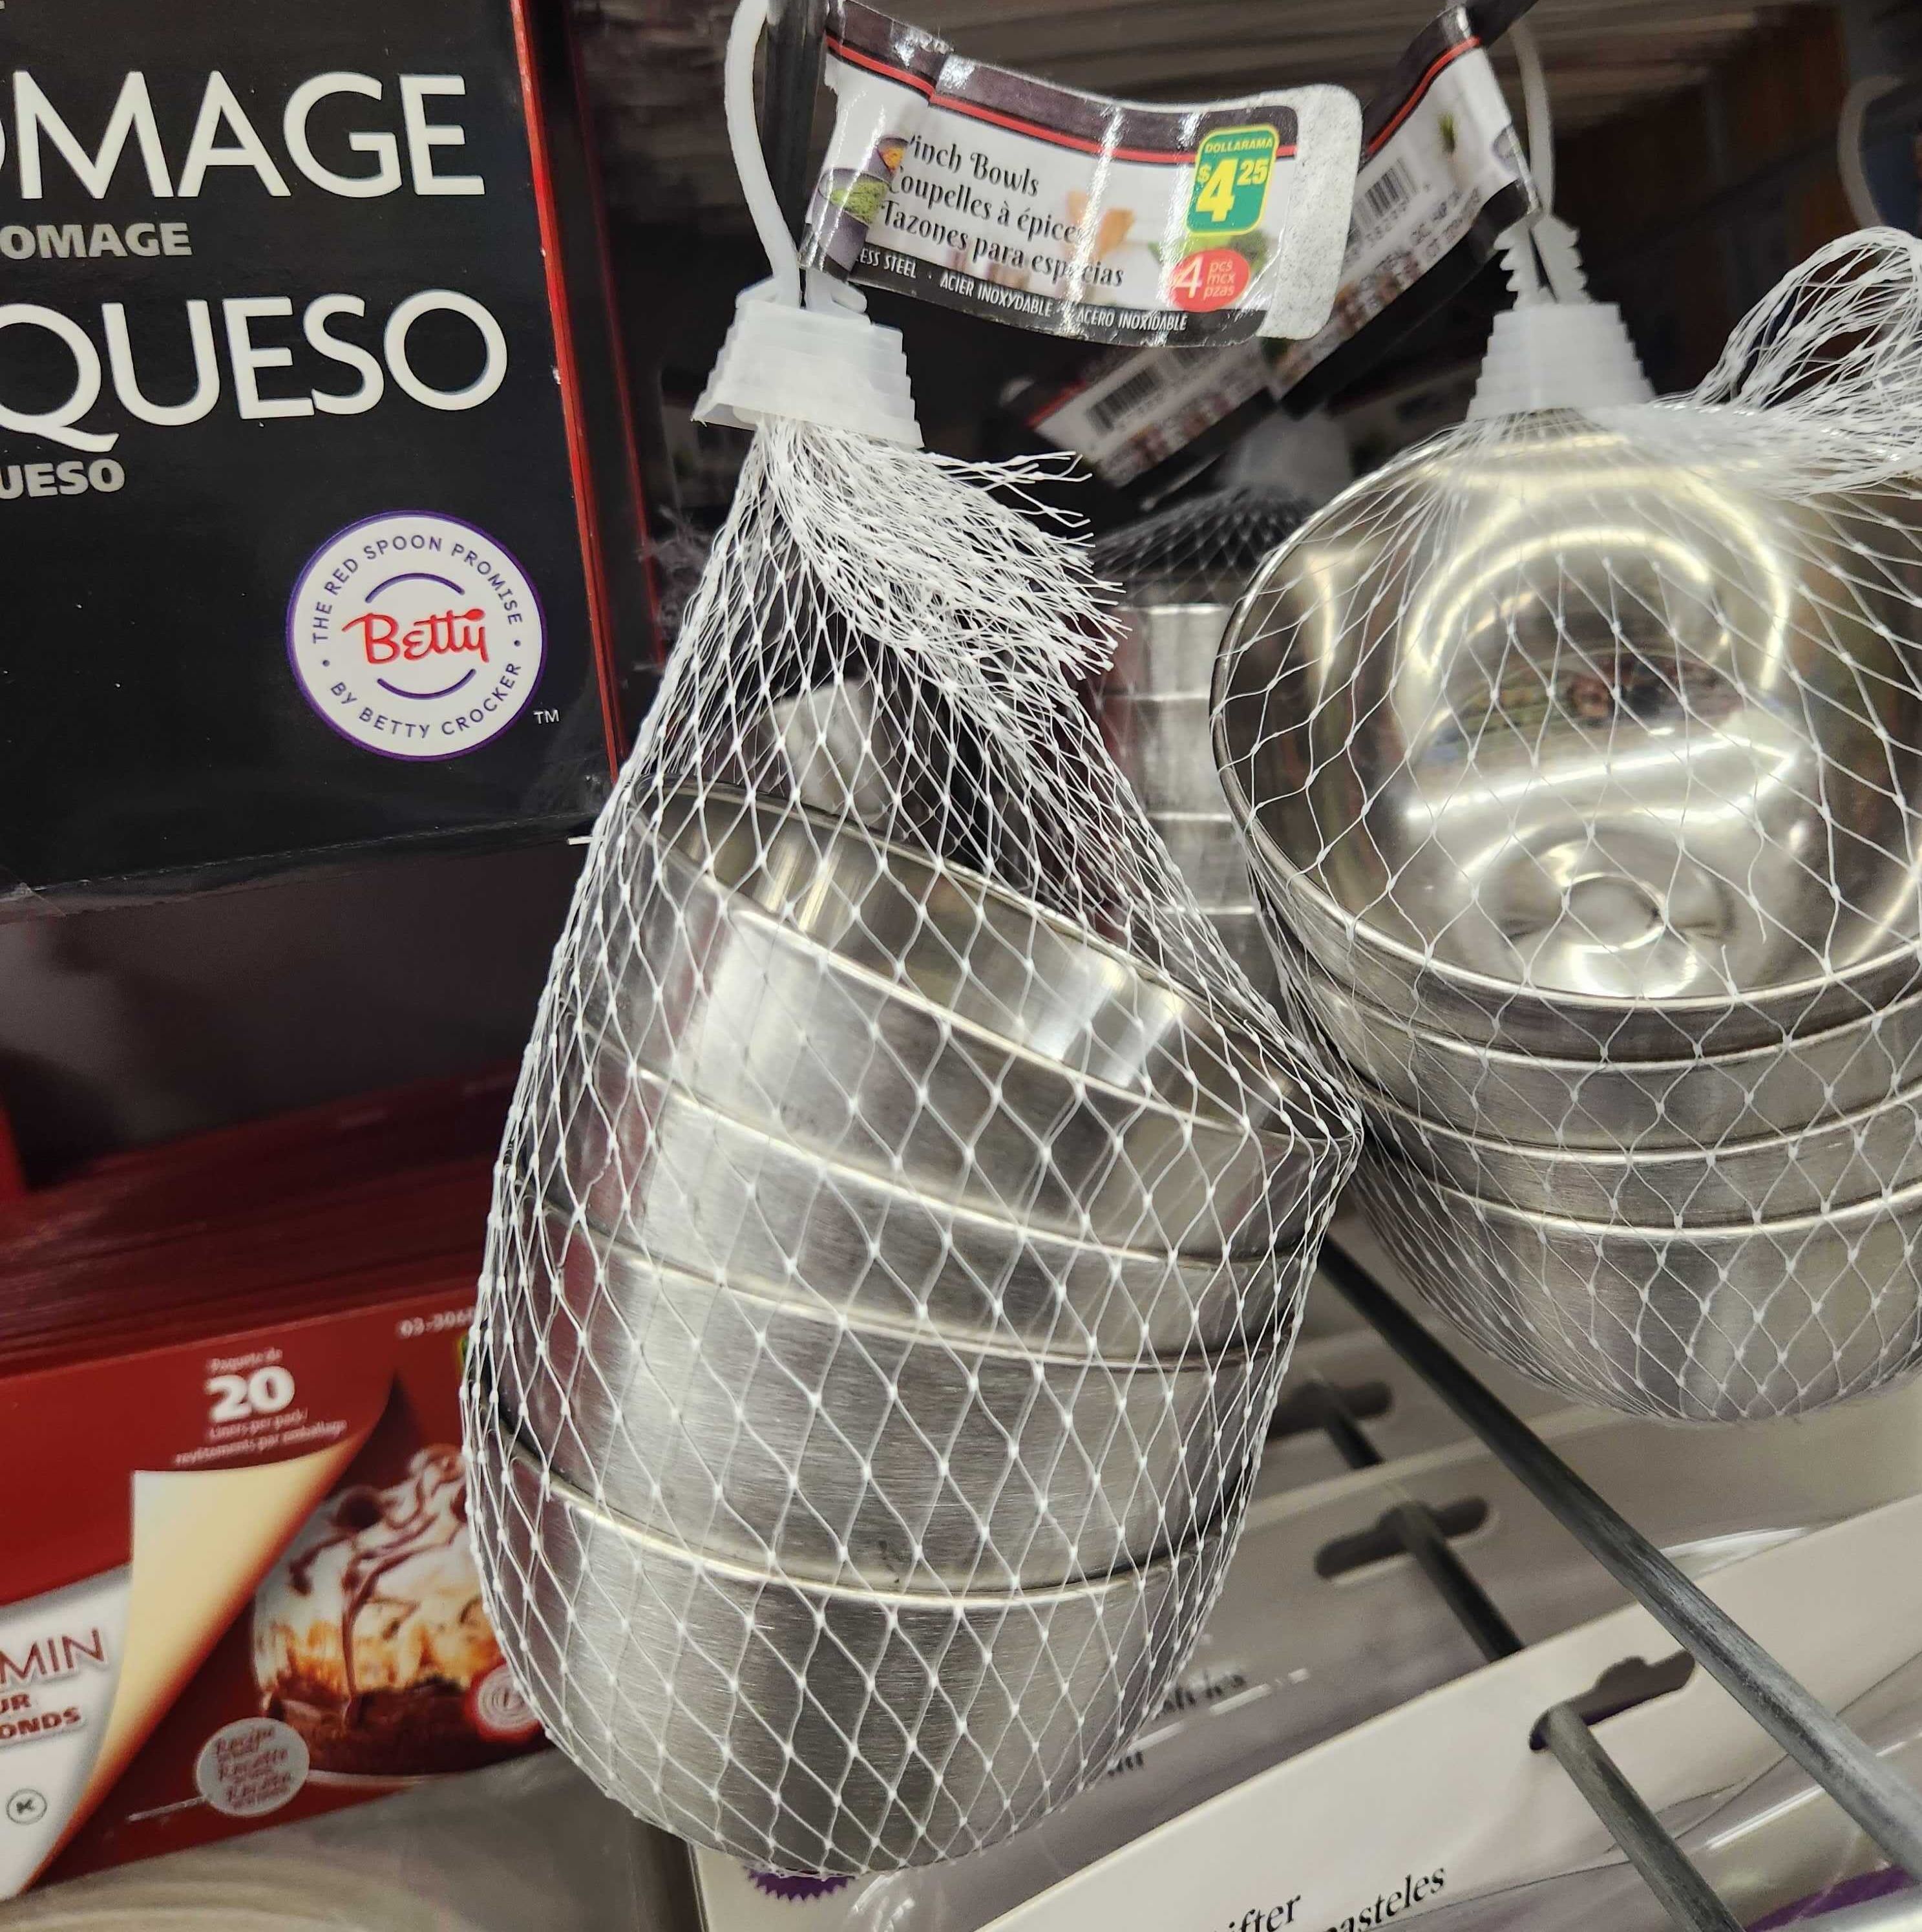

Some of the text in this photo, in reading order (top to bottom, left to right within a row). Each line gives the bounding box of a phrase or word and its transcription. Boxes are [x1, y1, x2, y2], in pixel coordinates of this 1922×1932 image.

[0, 70, 485, 199] MAGE
[1205, 138, 1273, 153] DOLLARAMA
[909, 134, 1039, 196] inch Bowls
[0, 223, 193, 259] OMAGE
[997, 200, 1010, 227] à
[880, 199, 1124, 287] Tazones para espcias
[856, 248, 1188, 331] ESS STEEL ACIER INOXYDABLE ACERO INOXIDABLE
[1174, 256, 1233, 299] 4 pcs
[1203, 285, 1234, 301] pzas
[1207, 273, 1235, 285] mcx
[0, 288, 507, 452] QUESO
[0, 458, 125, 499] UESO
[312, 535, 523, 644] THE RED SPOON PROMISE
[341, 608, 490, 664] Betty
[330, 663, 522, 738] BY BETTY CROCKER
[533, 709, 560, 724] TM
[205, 1365, 295, 1422] 20
[1322, 1867, 1446, 1932] asteles
